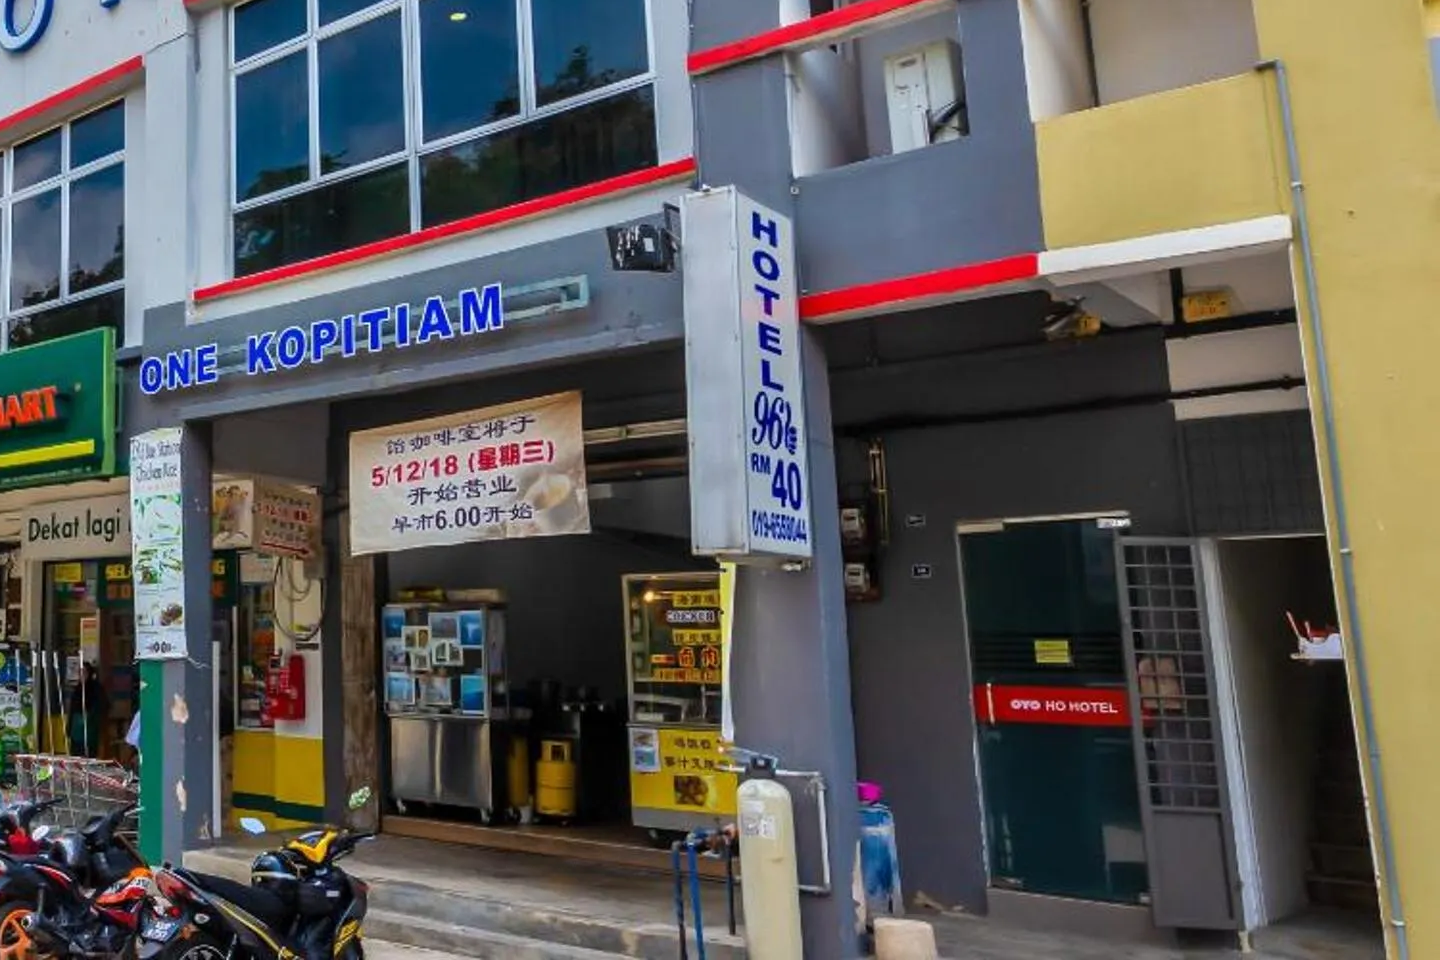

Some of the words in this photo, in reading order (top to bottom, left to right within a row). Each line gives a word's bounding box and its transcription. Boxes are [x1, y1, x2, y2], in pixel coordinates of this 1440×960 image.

[752, 211, 784, 391] HOTEL
[140, 344, 219, 395] ONE
[246, 283, 504, 374] KOPITIAM
[372, 454, 458, 487] 5/12/18
[468, 440, 555, 474] (星期三)
[751, 453, 771, 474] RM
[772, 460, 802, 511] 40
[408, 474, 517, 506] 开始营业
[28, 511, 79, 541] Dekat
[86, 508, 121, 542] lagi
[1010, 699, 1040, 710] OYO
[1045, 700, 1067, 712] HO
[1068, 701, 1118, 714] HOTEL
